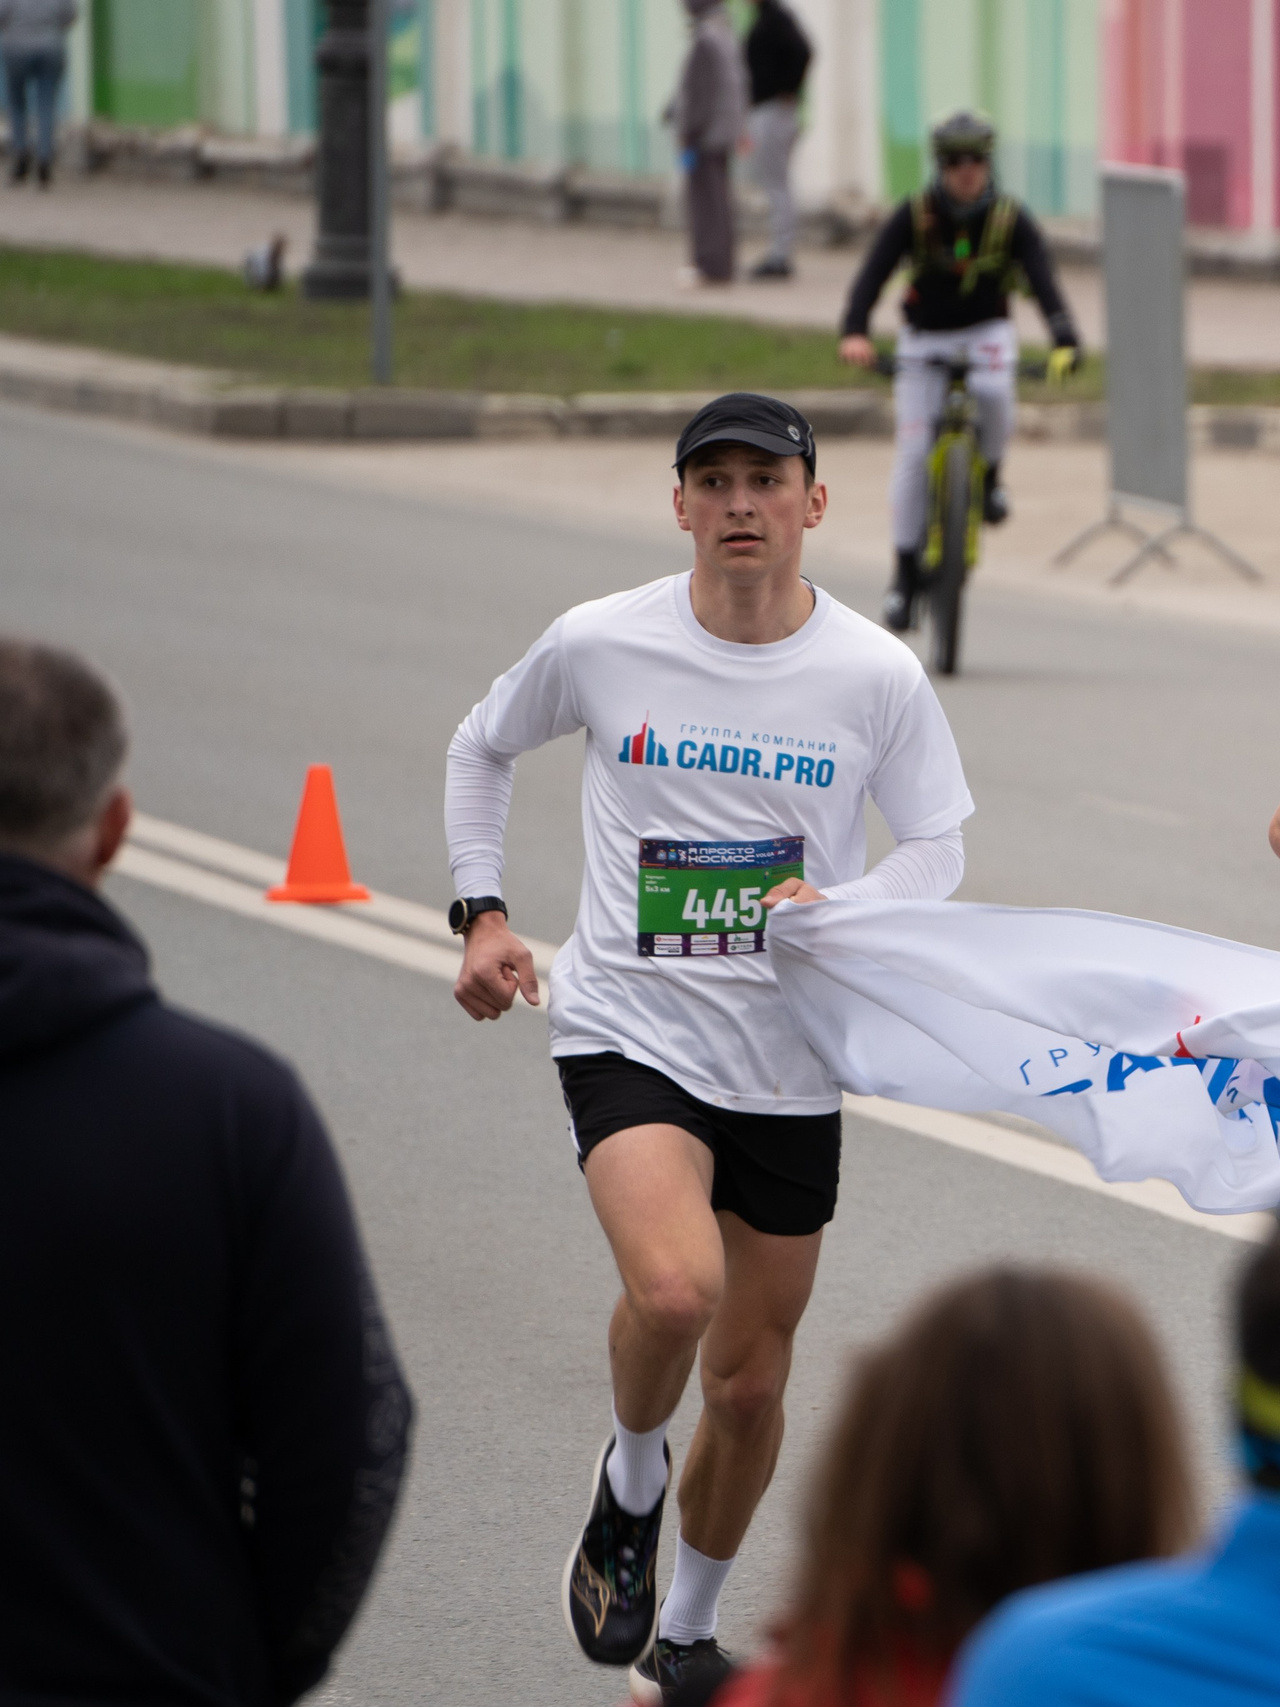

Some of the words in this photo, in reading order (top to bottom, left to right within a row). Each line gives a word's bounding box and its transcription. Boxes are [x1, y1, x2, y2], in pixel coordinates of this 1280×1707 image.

[680, 723, 742, 740] ГРУППА
[751, 732, 837, 753] КОМПАНИЙ
[676, 740, 836, 788] CADR.PRO
[688, 855, 756, 863] КОСМОС
[699, 847, 756, 855] ПРОСТО
[682, 887, 763, 929] 445
